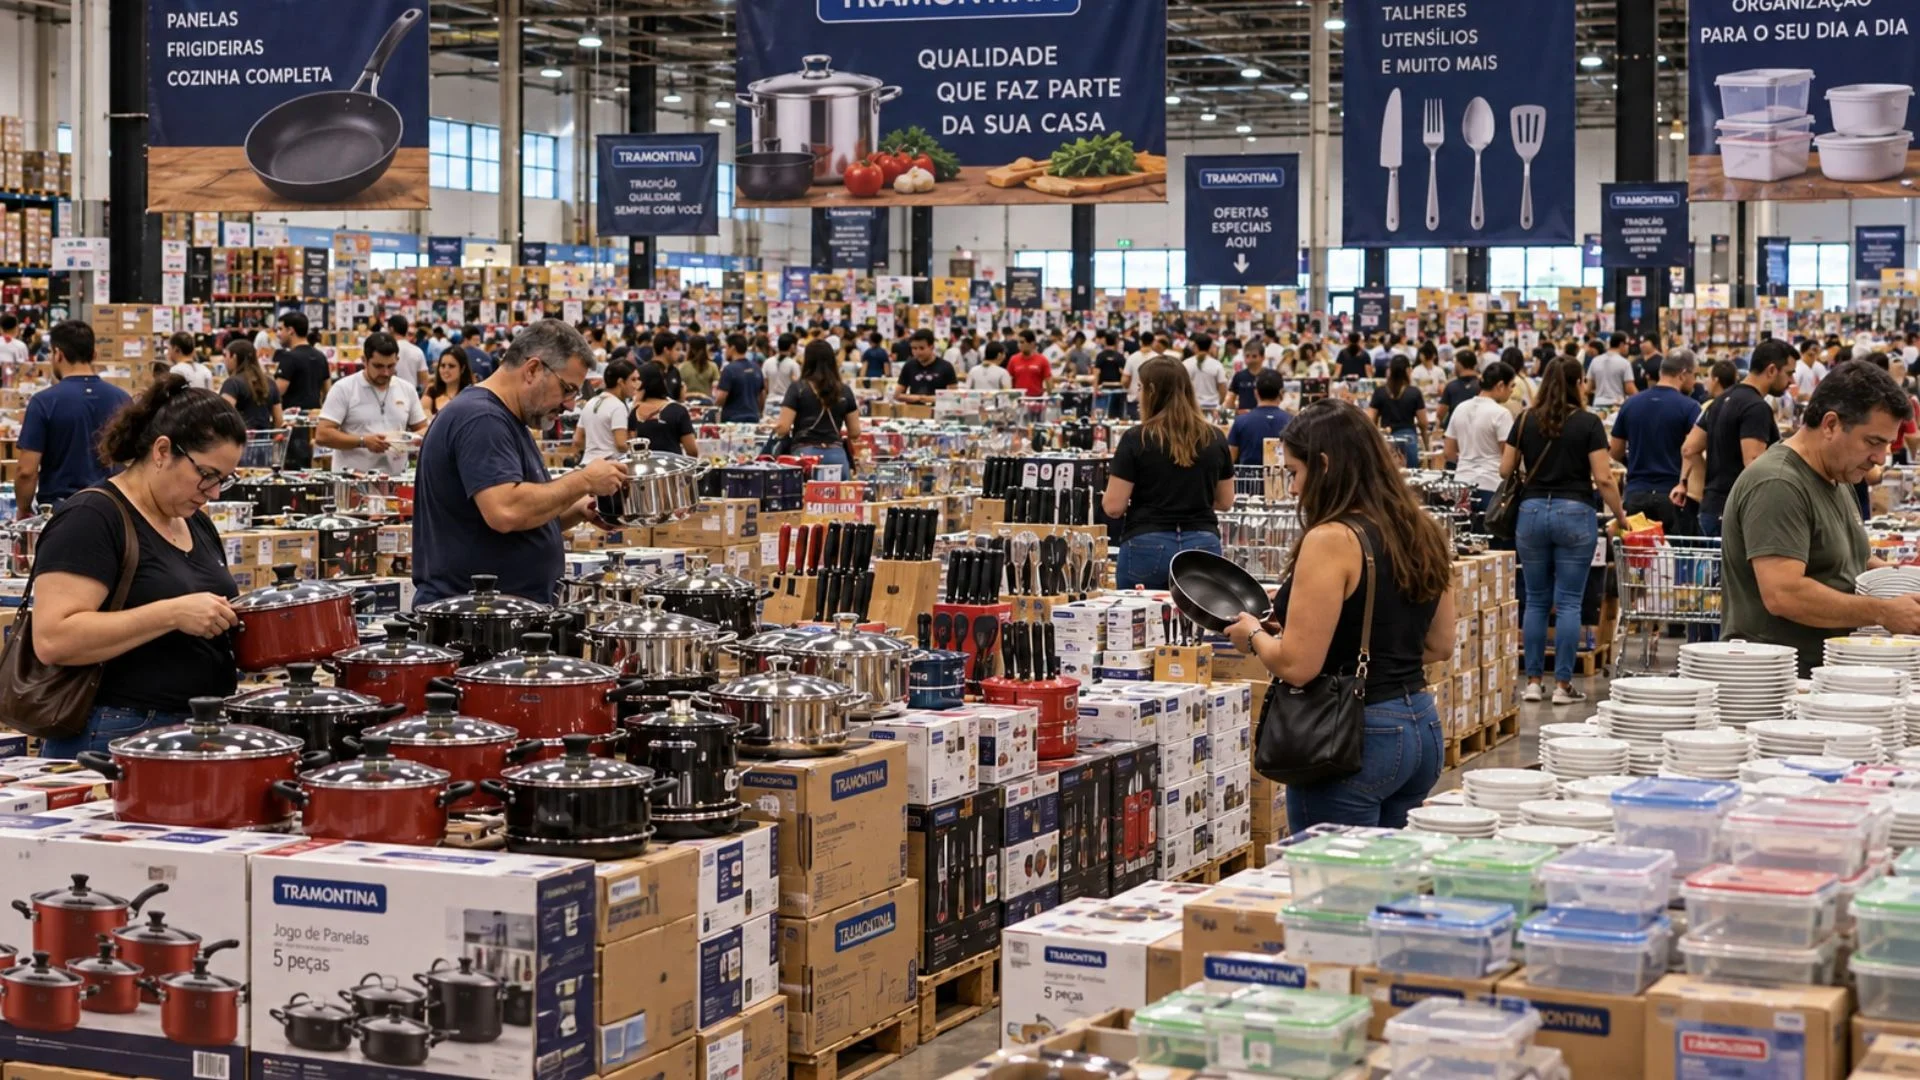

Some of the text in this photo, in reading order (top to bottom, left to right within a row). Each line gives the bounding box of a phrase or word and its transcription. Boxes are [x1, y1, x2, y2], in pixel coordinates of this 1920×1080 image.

[167, 11, 239, 28] PANELAS
[1382, 3, 1467, 21] TALHERES
[1700, 18, 1909, 44] PARA O SEU DIA A DIA
[167, 39, 264, 57] FRIGIDEIRAS
[918, 46, 1058, 70] QUALIDADE
[1381, 54, 1498, 74] E MUITO MAIS
[167, 67, 332, 86] COZINHA COMPLETA
[936, 78, 1121, 103] QUE FAZ PARTE
[942, 112, 1106, 135] DA SUA CASA
[619, 151, 696, 162] TRAMONTINA
[1205, 173, 1278, 184] TRAMONTINA
[628, 192, 681, 202] QUALIDADE
[1615, 195, 1675, 205] TRAMONTINA
[614, 203, 703, 215] SEMPRE COM VOCÊ
[1213, 206, 1269, 218] OFERTAS
[1211, 222, 1272, 233] ESPECIAIS
[1225, 237, 1257, 249] AQUI
[281, 884, 378, 907] TRAMONTINA
[273, 923, 370, 946] Jogo de Panelas
[273, 948, 331, 975] 5 peças
[1049, 950, 1102, 965] TRAMONTINA
[1212, 962, 1299, 984] TRAMONTINA
[1054, 990, 1084, 1005] peças
